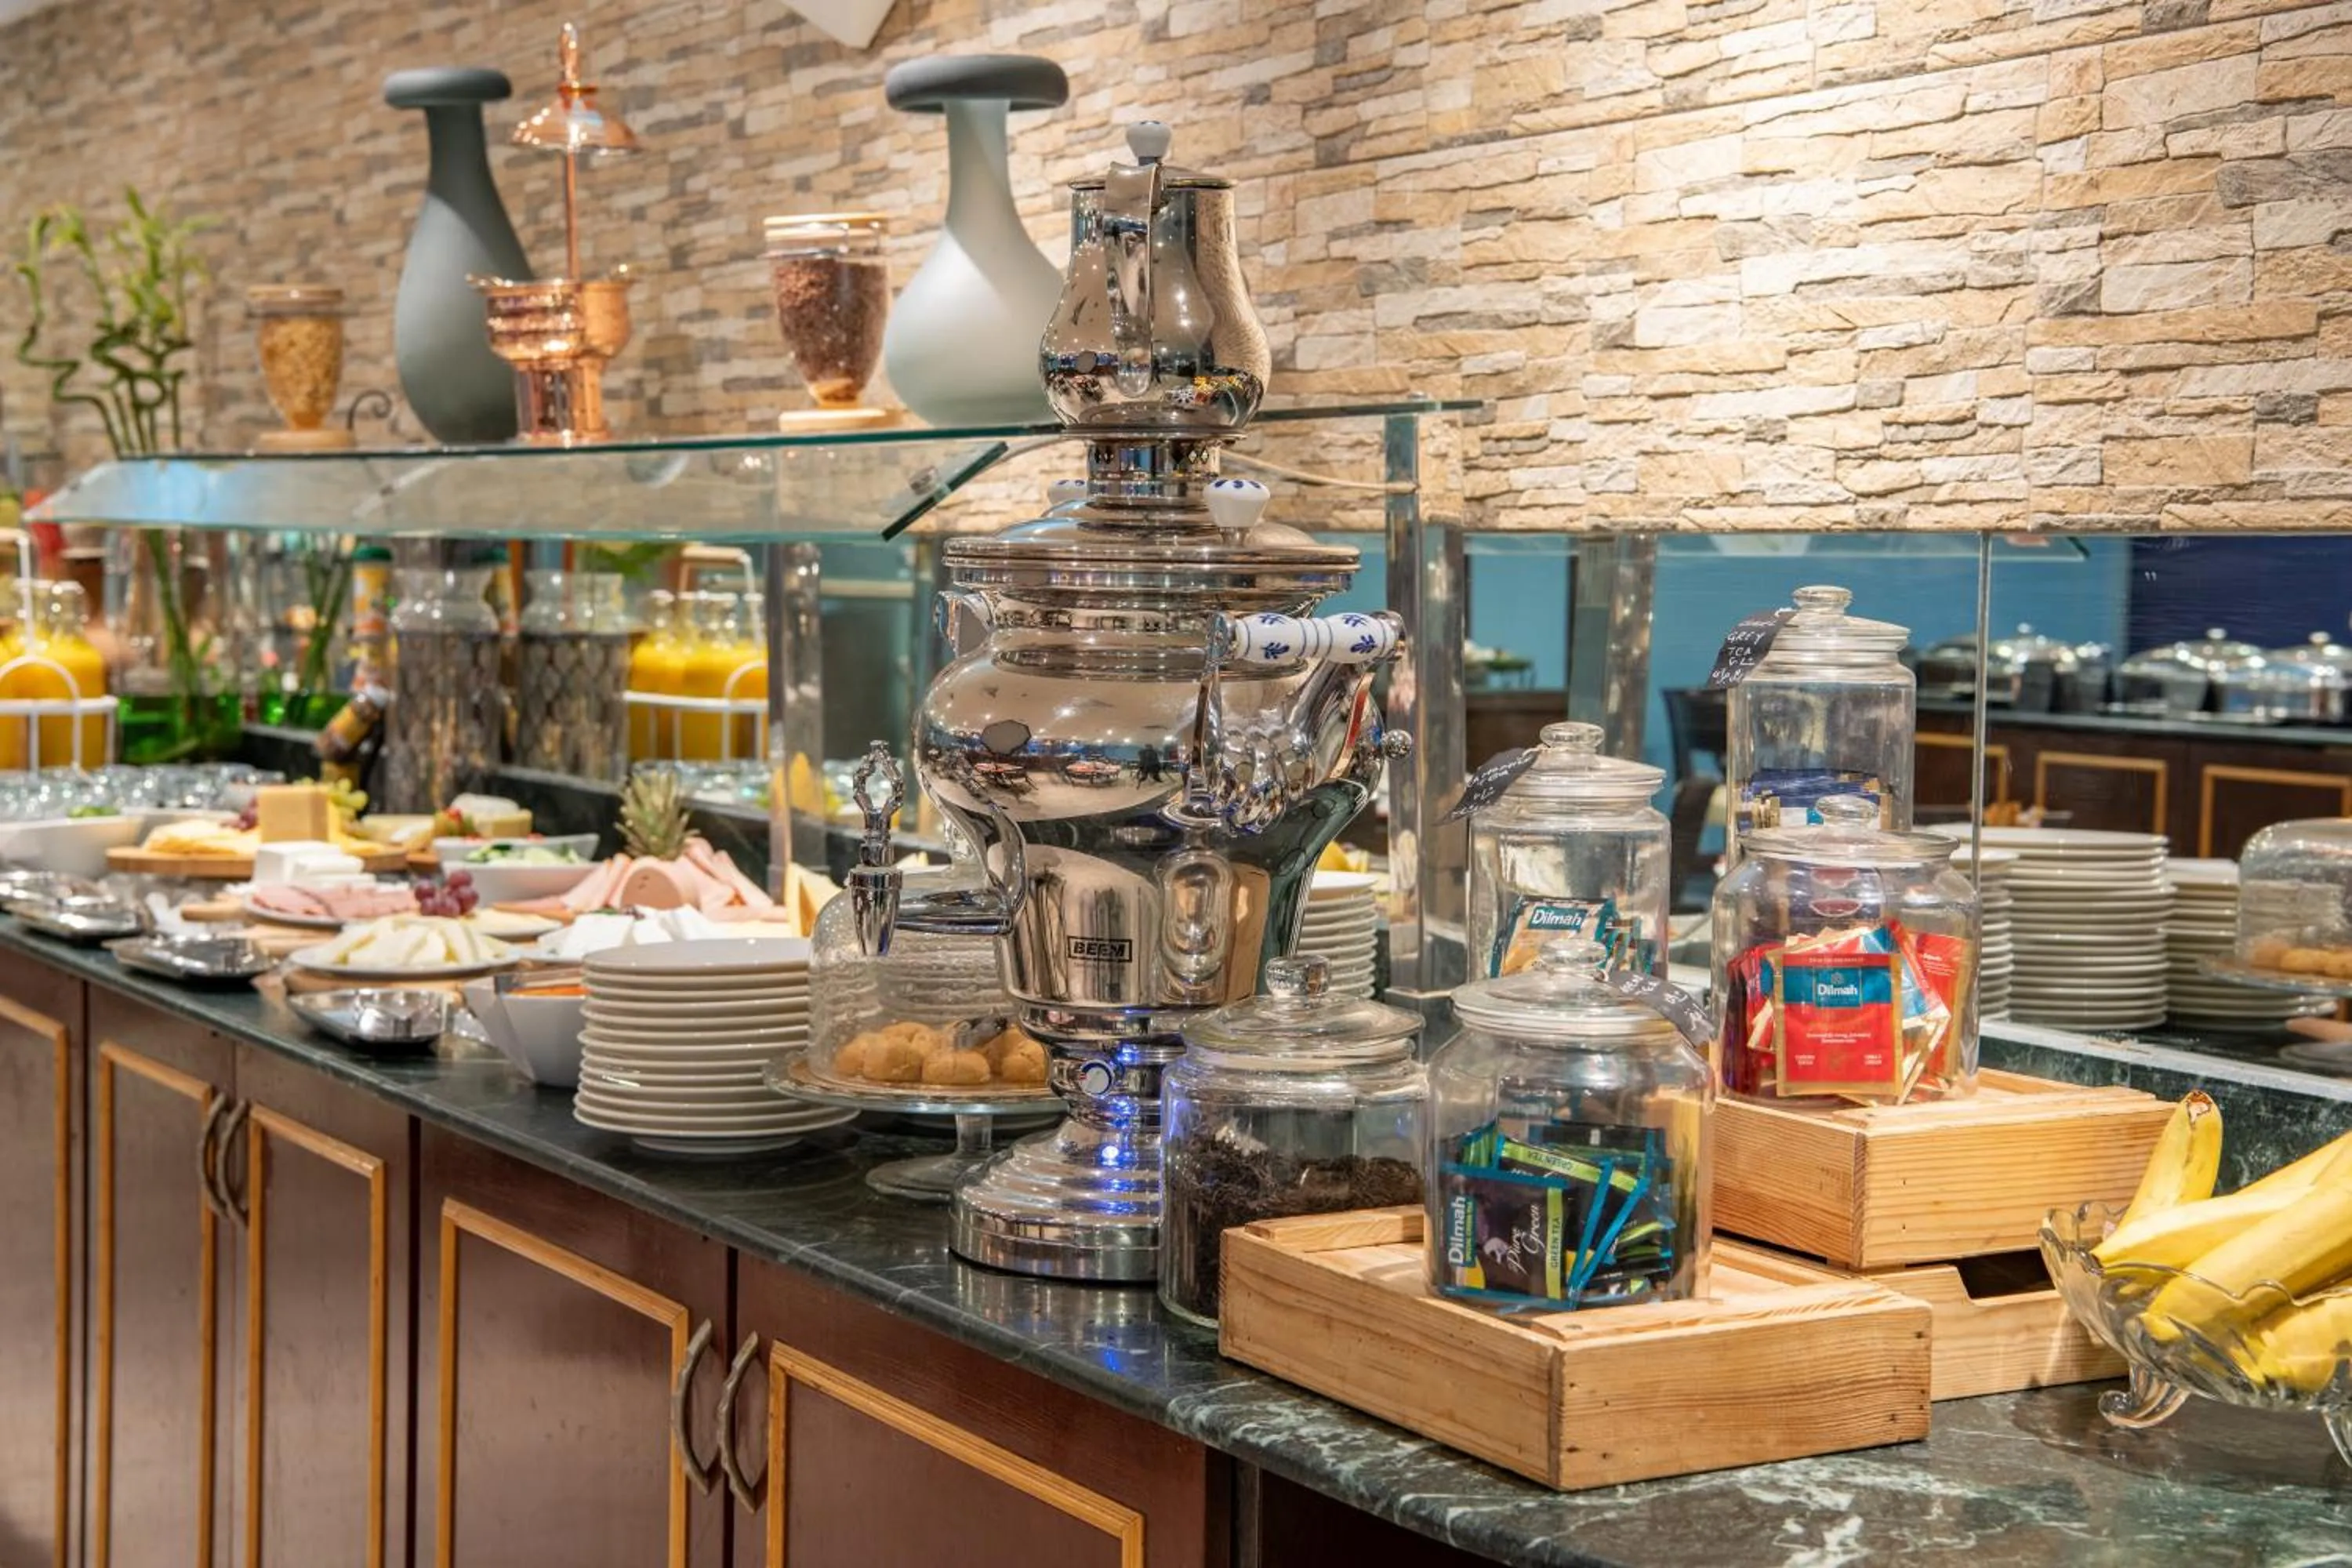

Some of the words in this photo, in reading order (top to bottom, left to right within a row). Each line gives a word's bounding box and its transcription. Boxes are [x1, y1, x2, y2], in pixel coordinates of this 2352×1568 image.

[1531, 909, 1582, 926] Dilmah
[1073, 941, 1126, 957] BEEM
[1817, 983, 1858, 995] Dilmah
[1448, 1196, 1466, 1264] Dilmah
[1520, 1204, 1546, 1254] Green
[1506, 1225, 1529, 1276] Pure
[1550, 1236, 1560, 1269] GREEN
